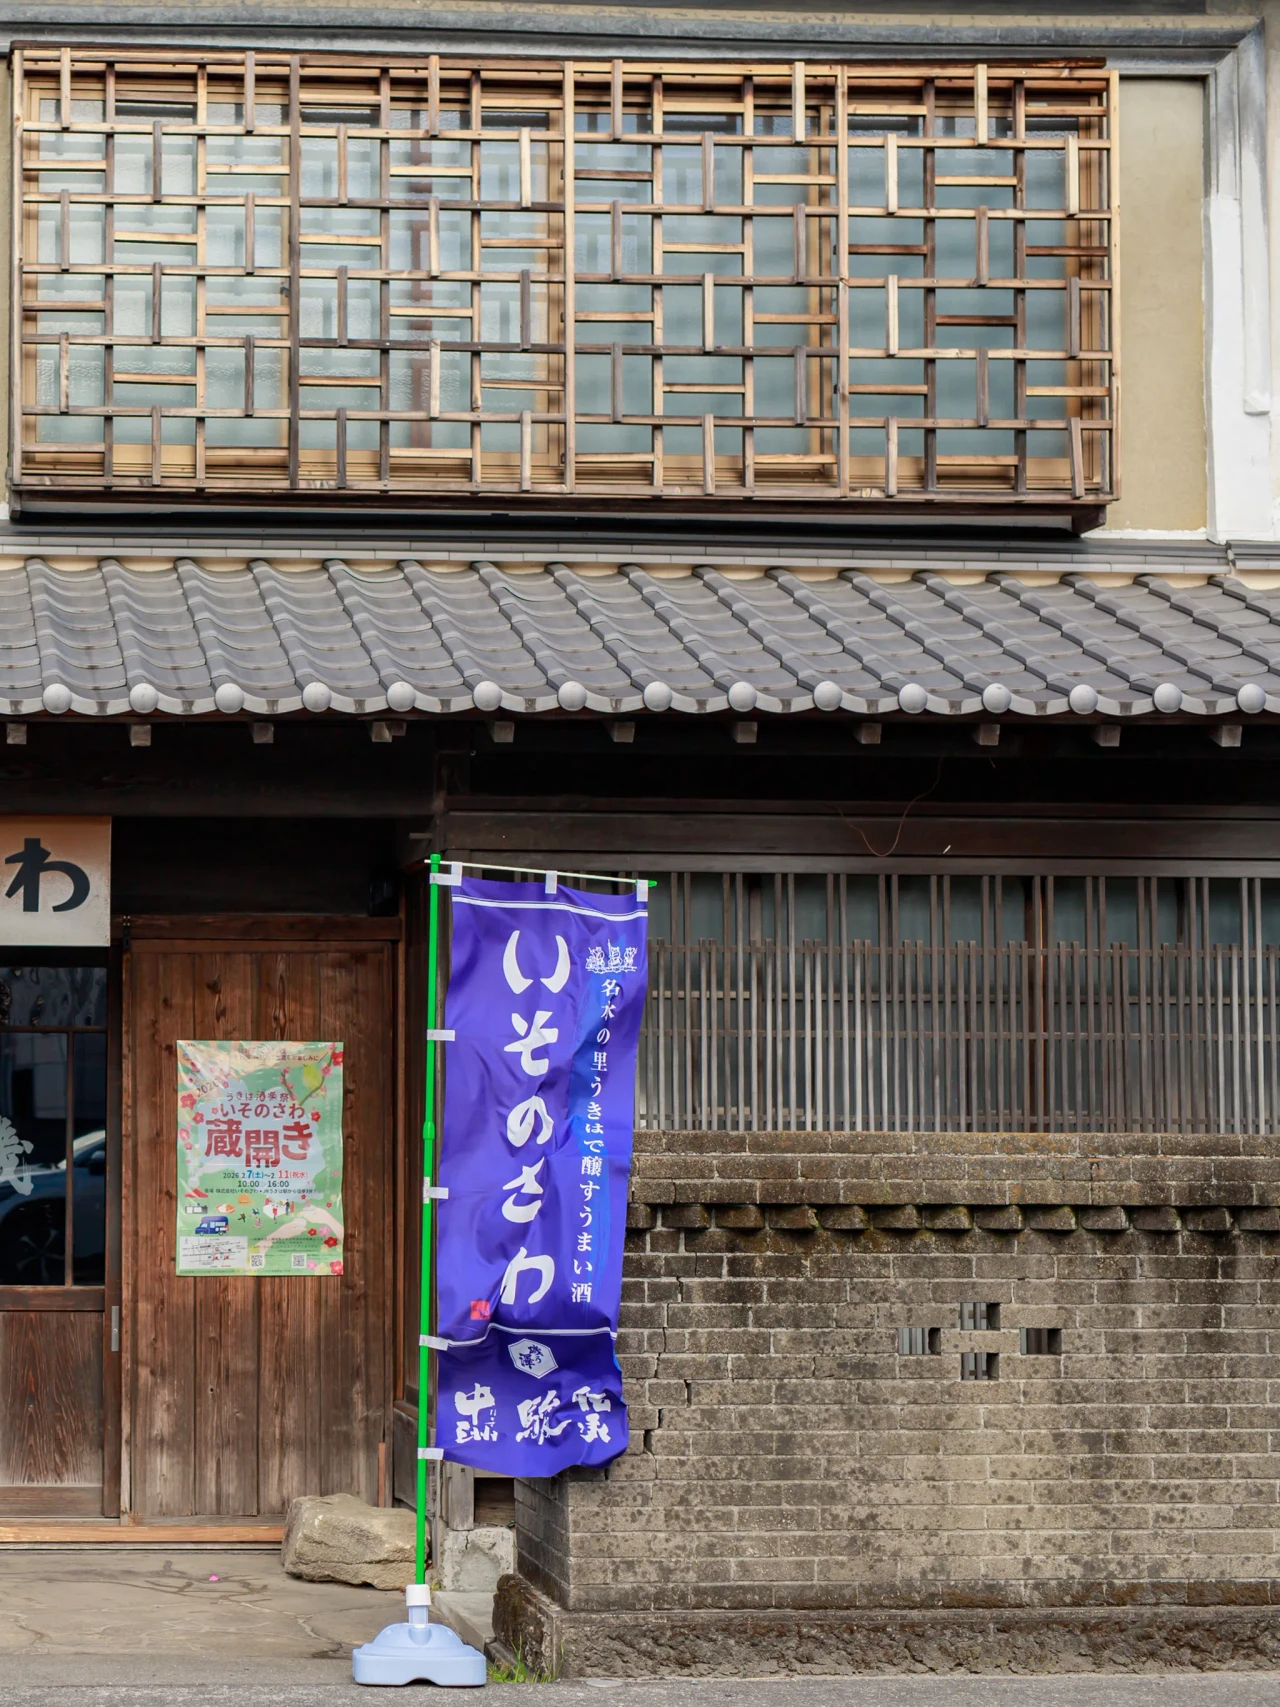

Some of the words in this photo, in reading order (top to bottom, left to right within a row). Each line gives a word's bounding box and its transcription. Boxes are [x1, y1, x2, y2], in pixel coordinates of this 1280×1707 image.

[220, 1102, 305, 1119] いそのさわ
[500, 930, 570, 1305] いそのさわ
[204, 1118, 313, 1168] 蔵開き
[571, 978, 620, 1303] 名水の里うきはで醸すうまい酒
[237, 1180, 260, 1188] 10:00
[268, 1180, 289, 1188] 16:00
